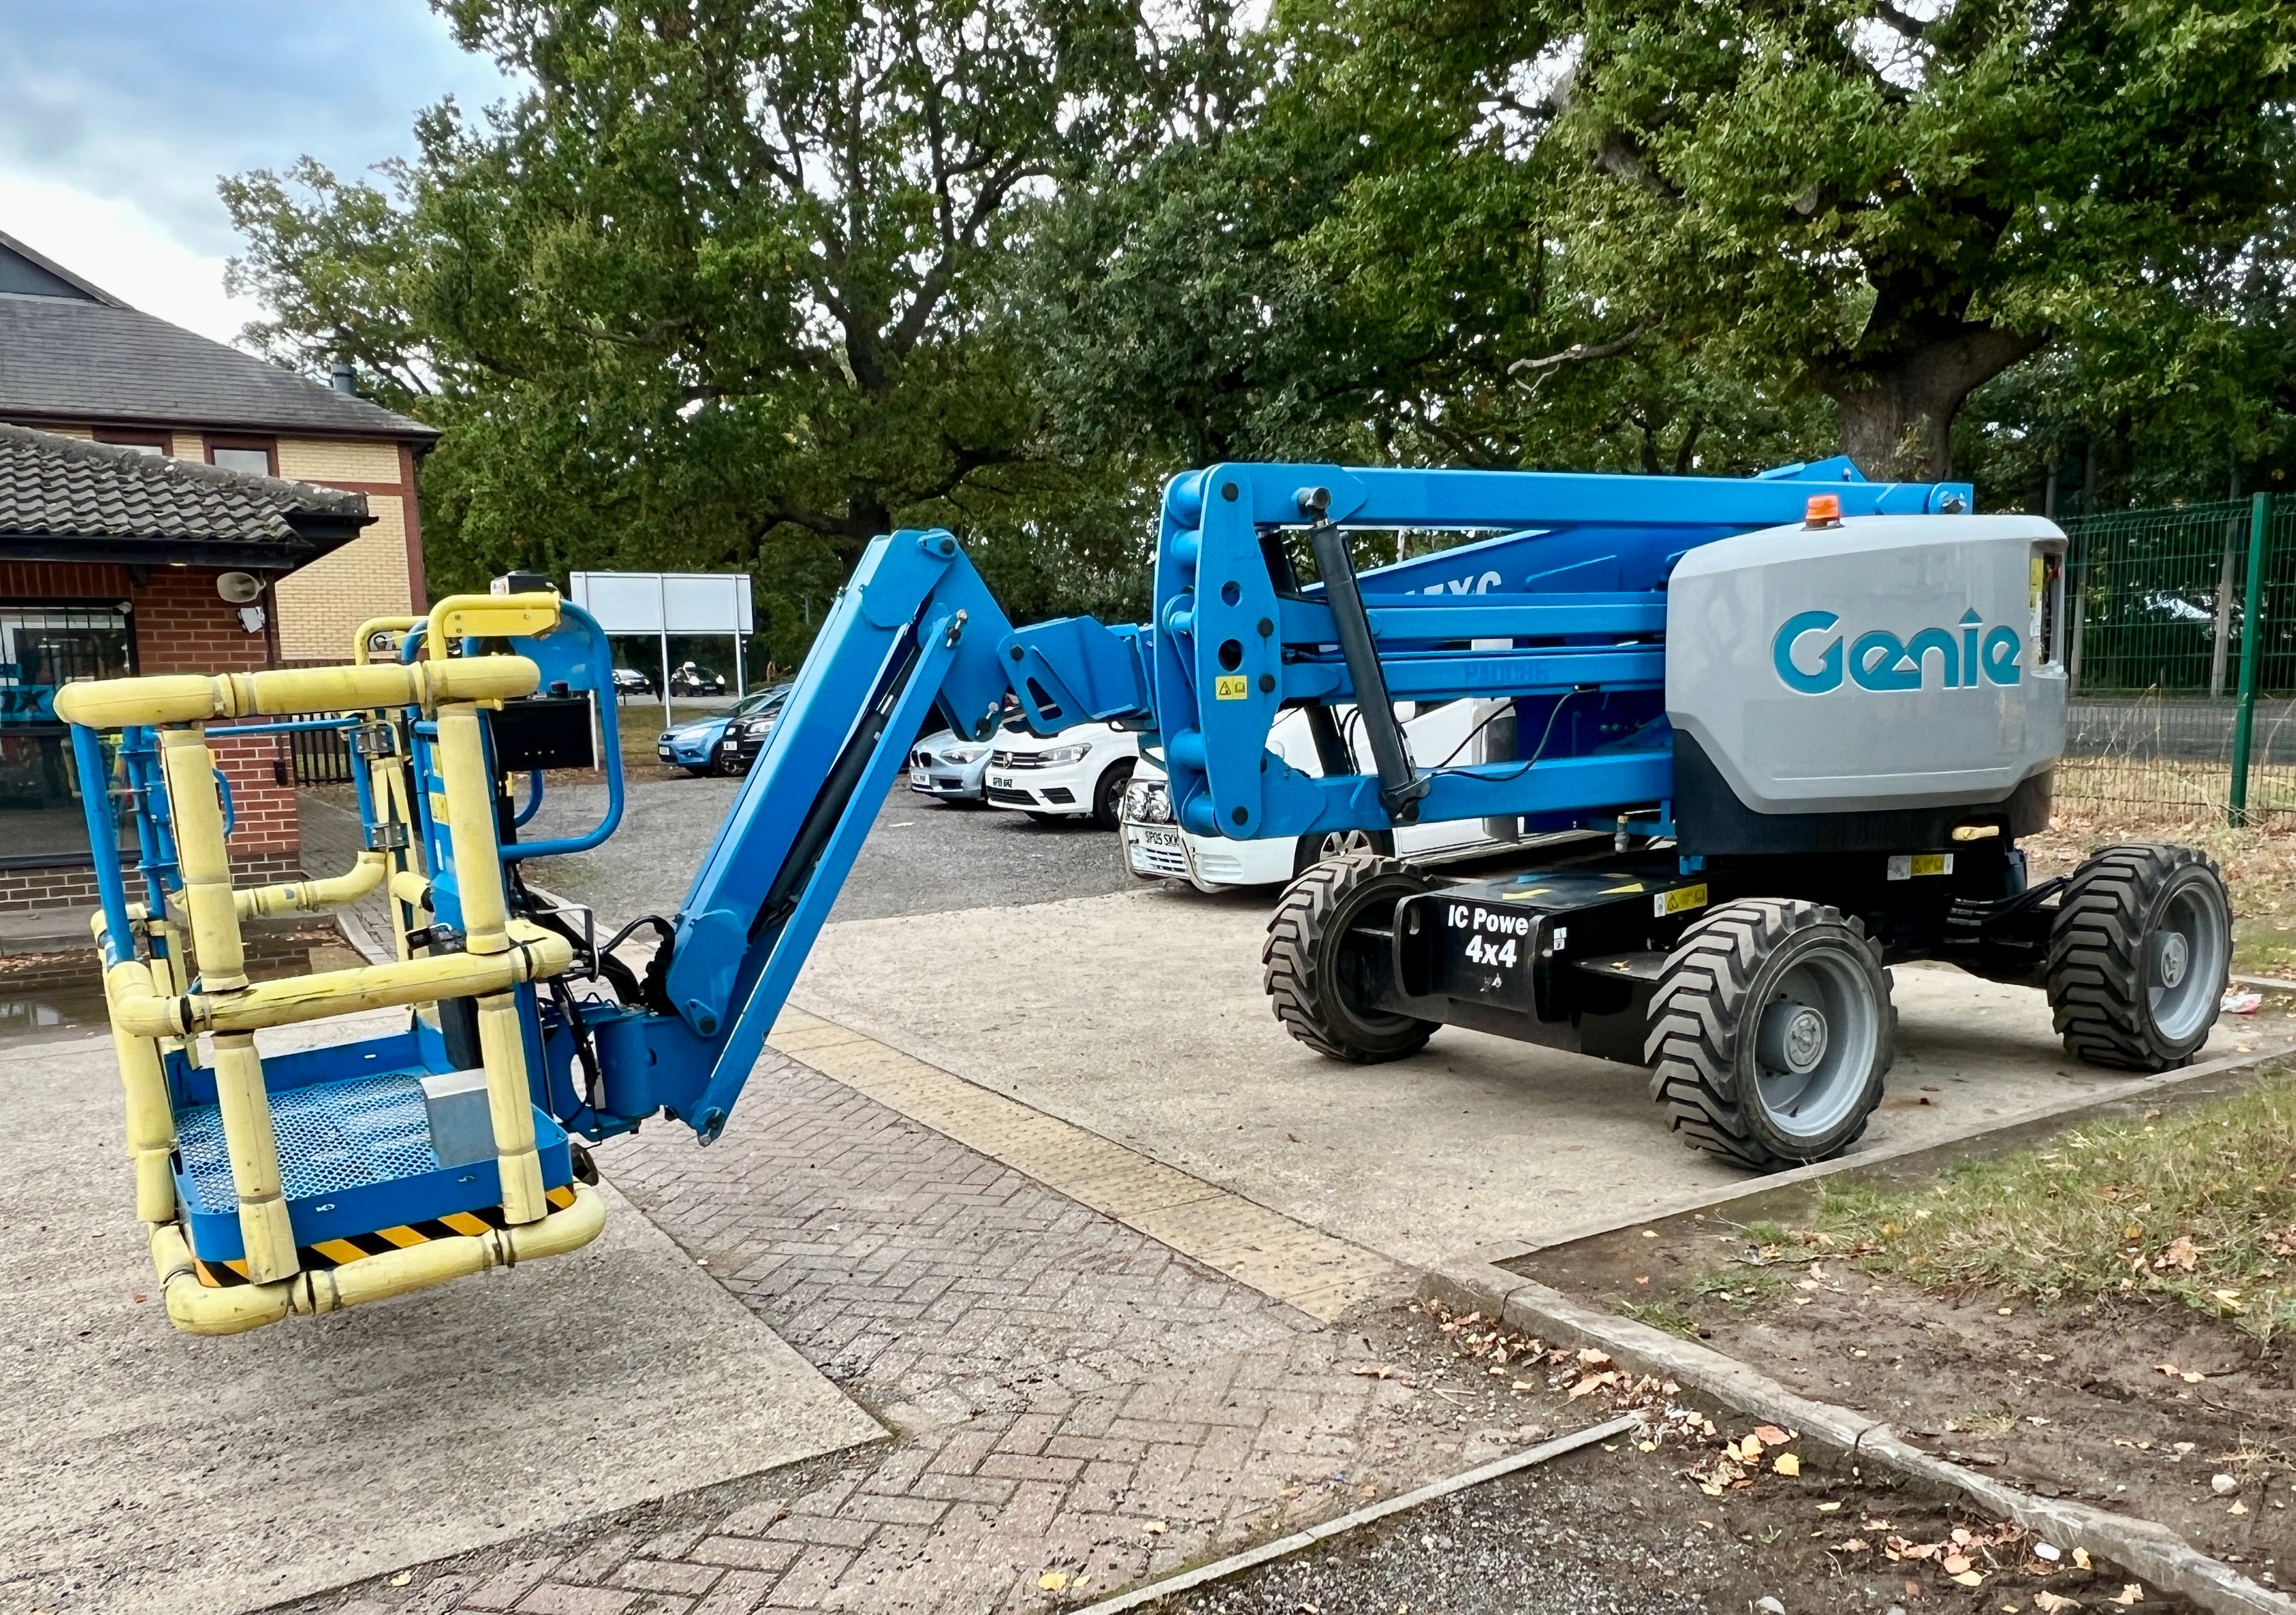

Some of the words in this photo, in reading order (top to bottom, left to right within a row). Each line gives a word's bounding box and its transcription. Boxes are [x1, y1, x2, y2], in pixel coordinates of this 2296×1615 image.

[1772, 606, 2021, 696] Genie
[1448, 904, 1469, 929] IC
[1473, 907, 1529, 936] Powe
[1465, 934, 1517, 968] 4x4
